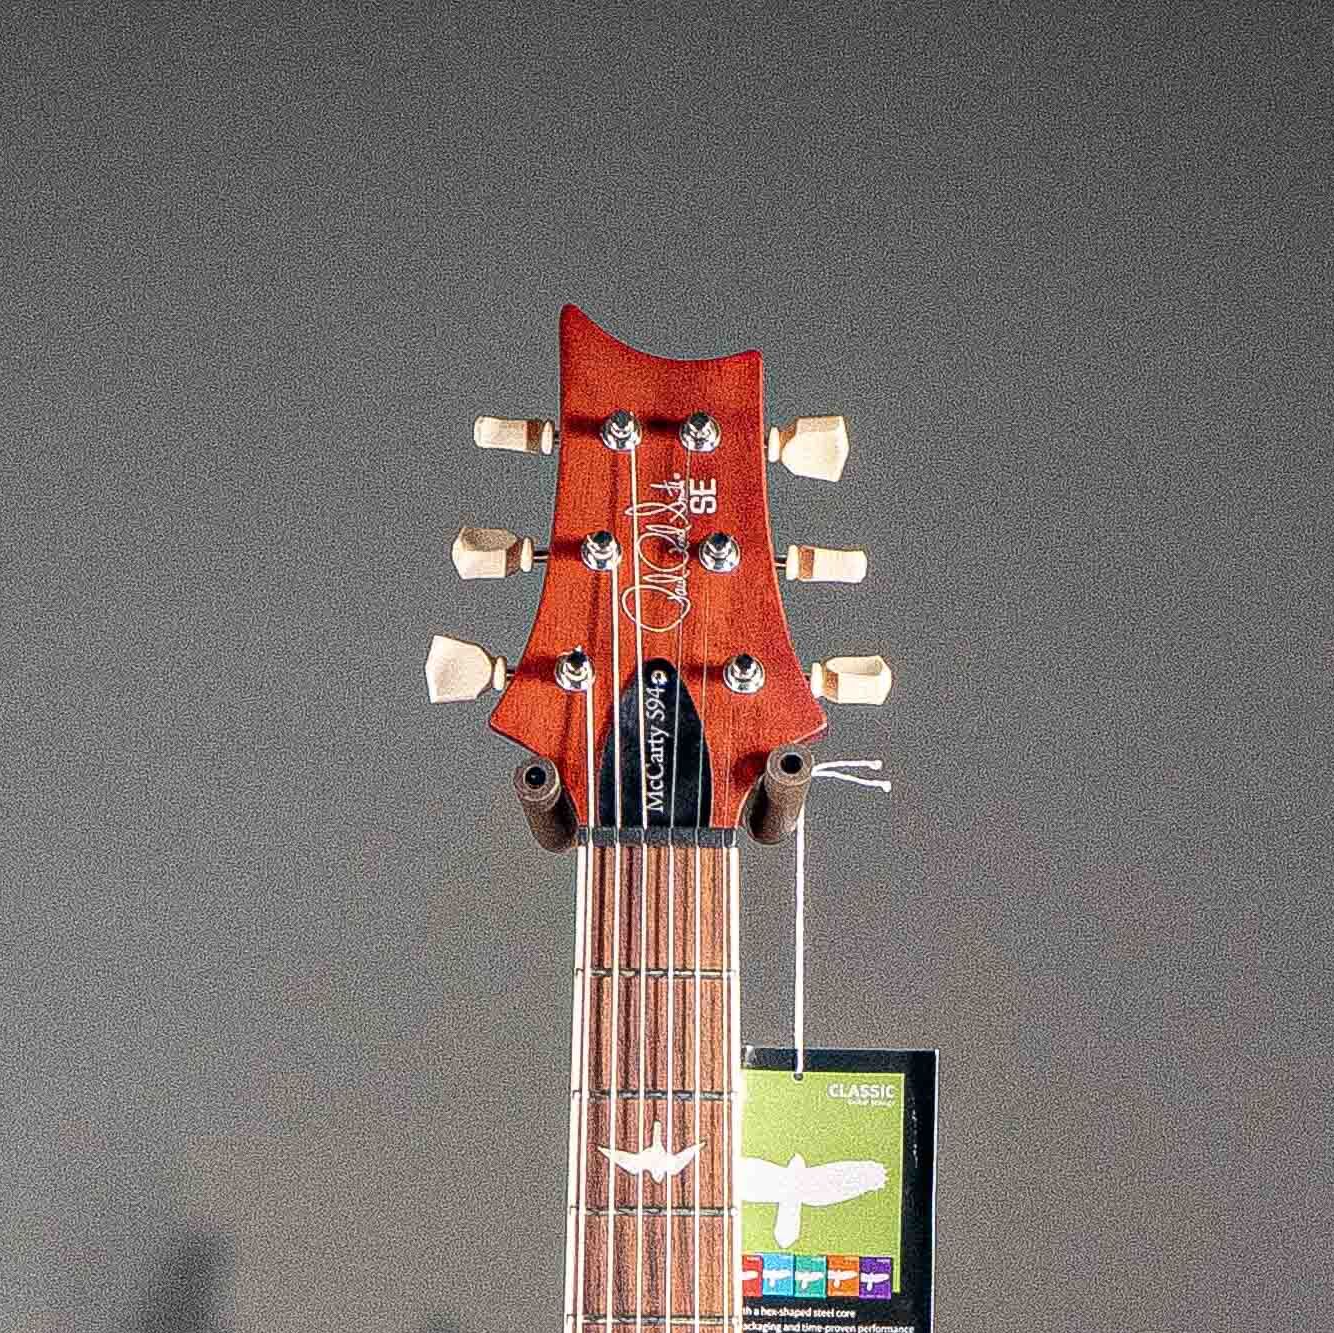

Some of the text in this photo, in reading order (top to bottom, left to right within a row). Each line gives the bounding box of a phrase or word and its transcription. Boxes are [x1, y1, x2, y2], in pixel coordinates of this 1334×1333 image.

[689, 478, 717, 514] SE
[645, 726, 669, 814] McCarty
[827, 1084, 895, 1099] CLASSIC
[761, 1306, 812, 1318] hex-shaped
[813, 1307, 835, 1318] steel
[836, 1309, 856, 1319] core
[783, 1322, 800, 1333] and
